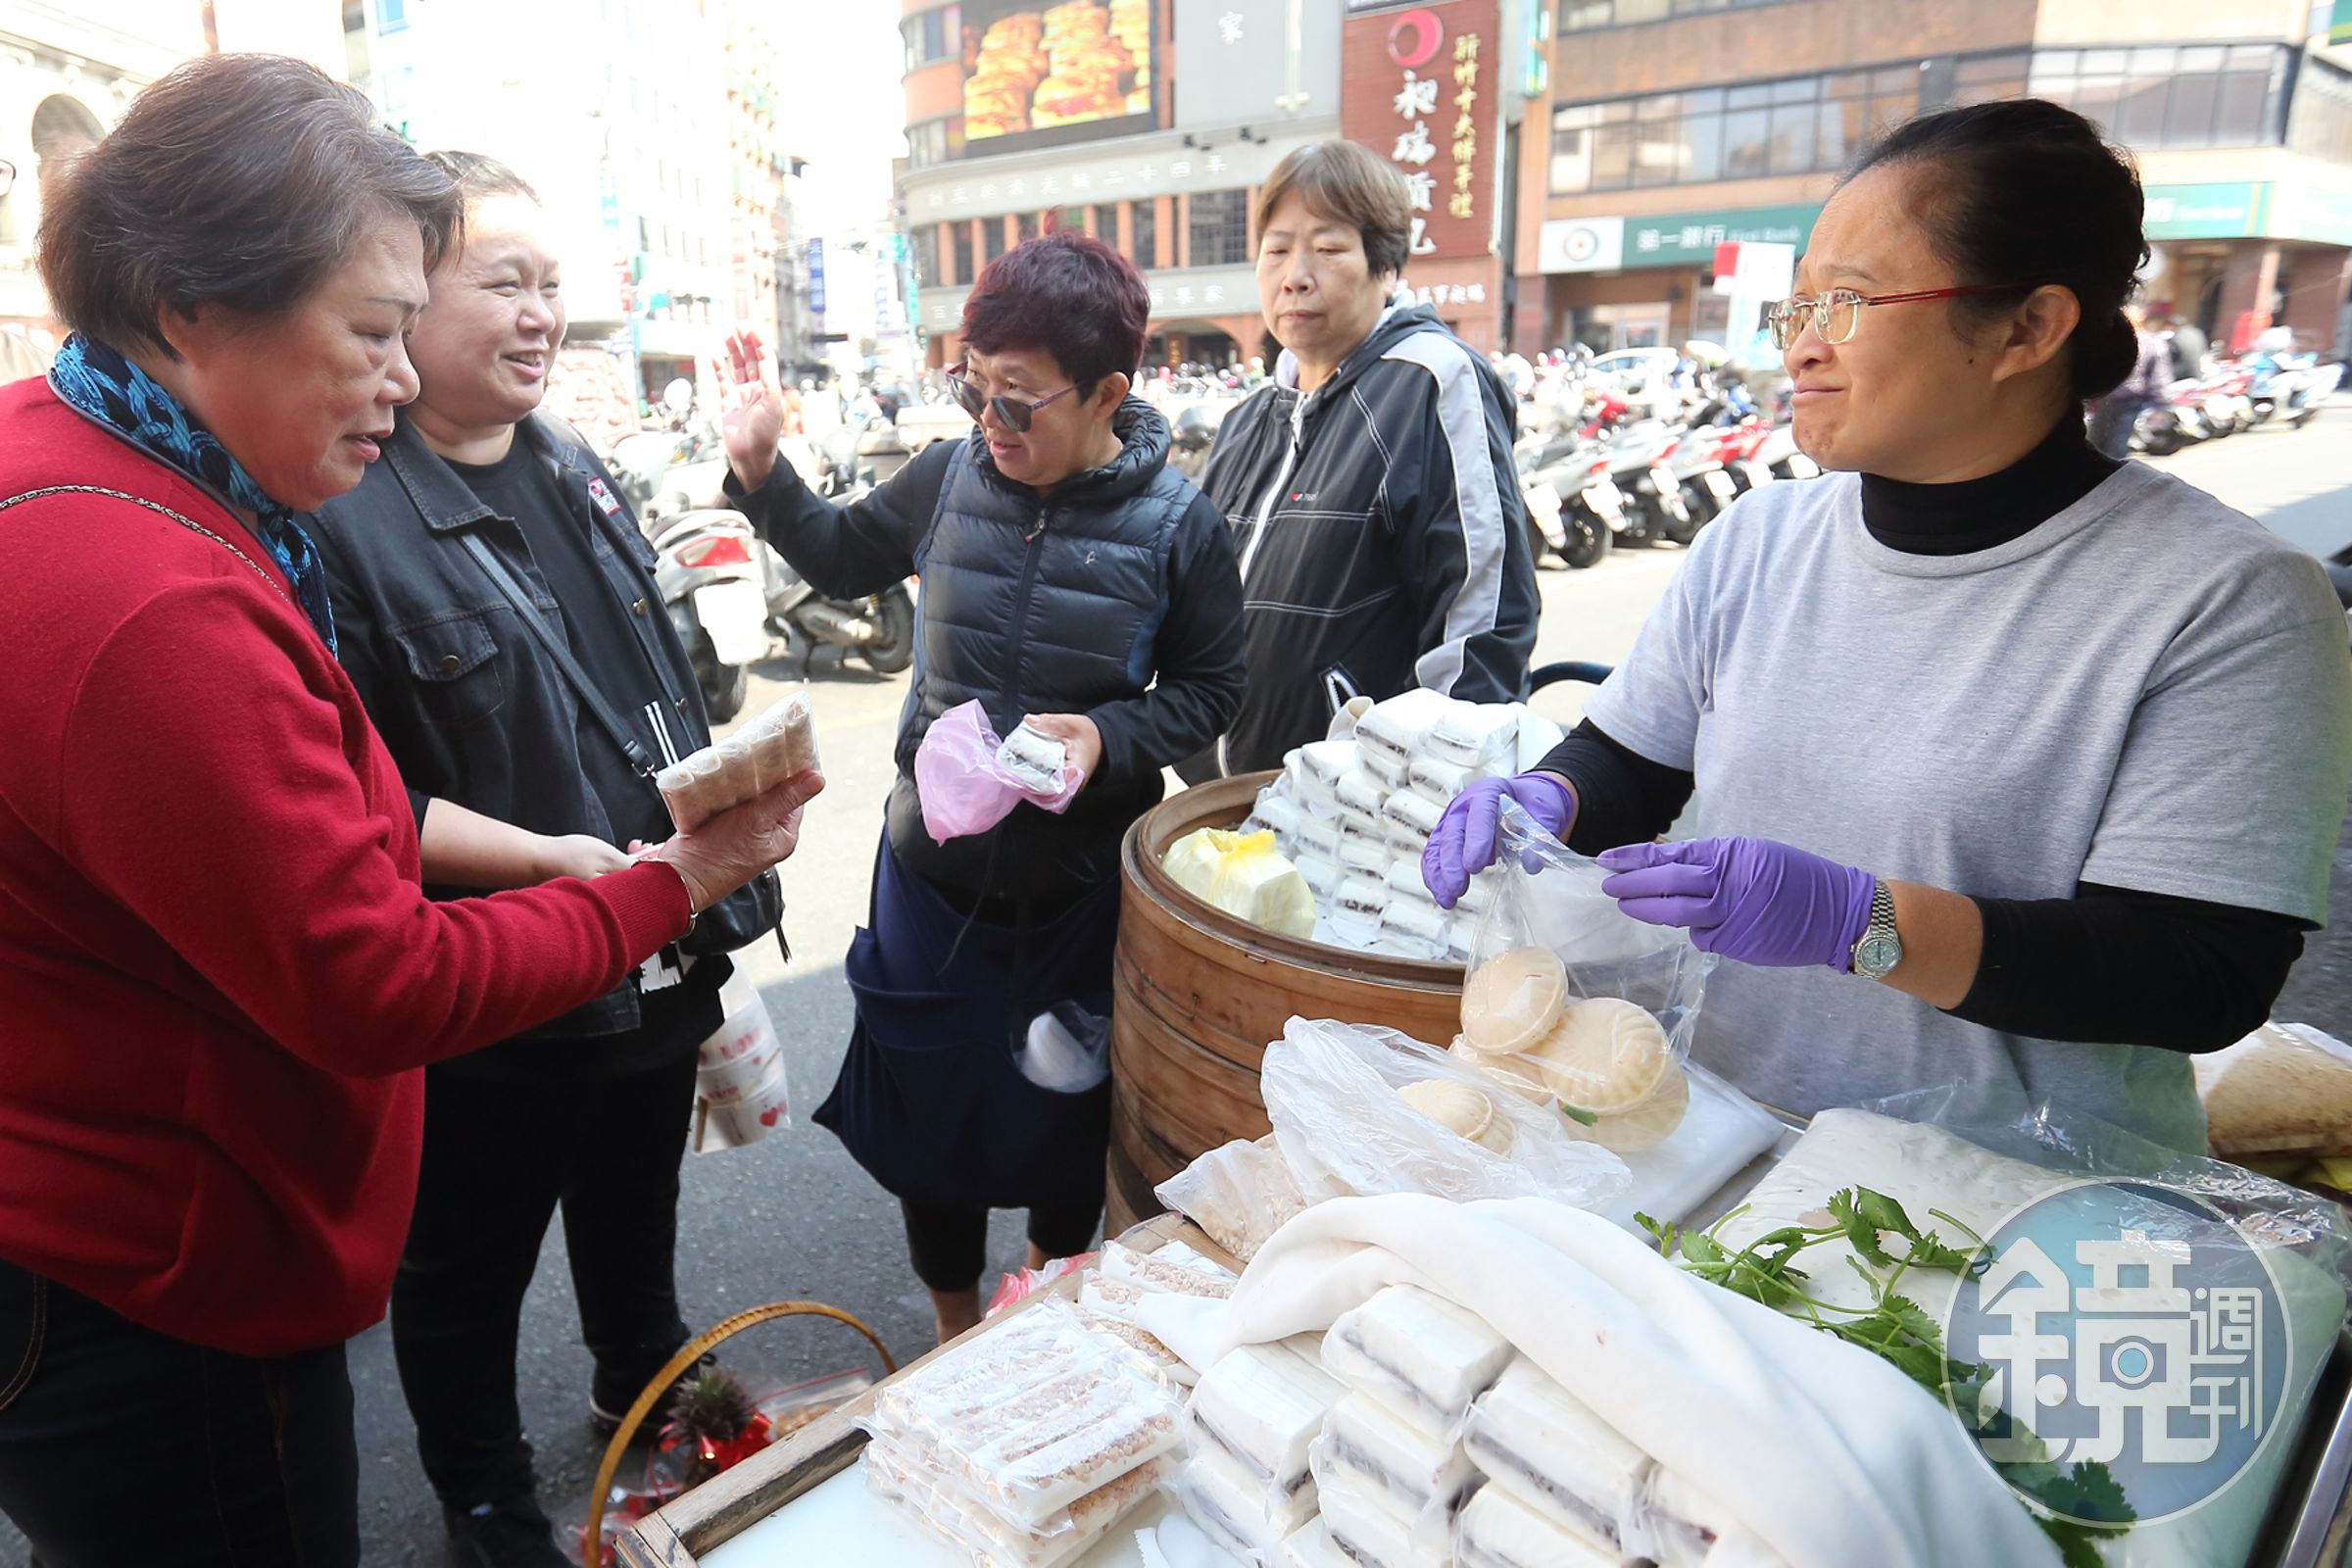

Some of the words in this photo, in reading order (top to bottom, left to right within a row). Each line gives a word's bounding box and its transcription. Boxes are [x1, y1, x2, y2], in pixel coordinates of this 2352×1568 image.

[1448, 32, 1481, 220] 新竹十大伴手禮
